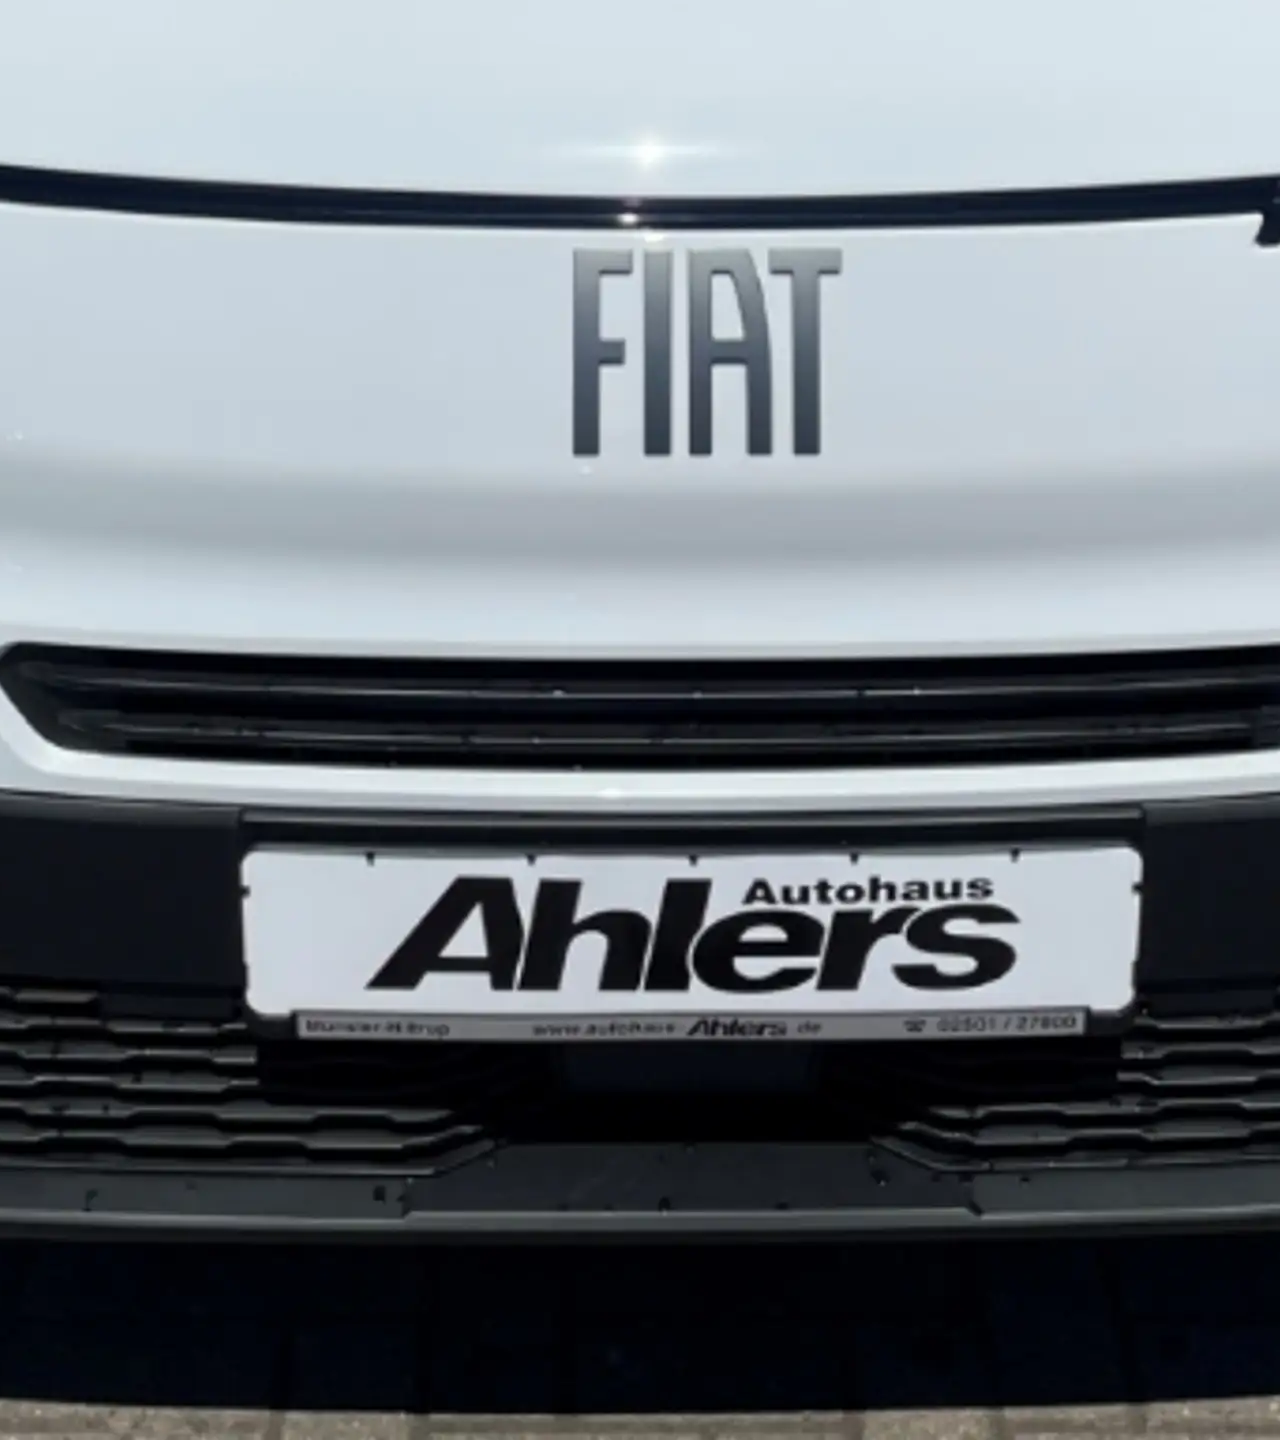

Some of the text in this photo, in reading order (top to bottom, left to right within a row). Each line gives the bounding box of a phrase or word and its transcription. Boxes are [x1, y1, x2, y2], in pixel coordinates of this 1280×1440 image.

[572, 247, 843, 458] FIAT
[363, 874, 1021, 994] Ahlers
[740, 875, 995, 906] Autohaus
